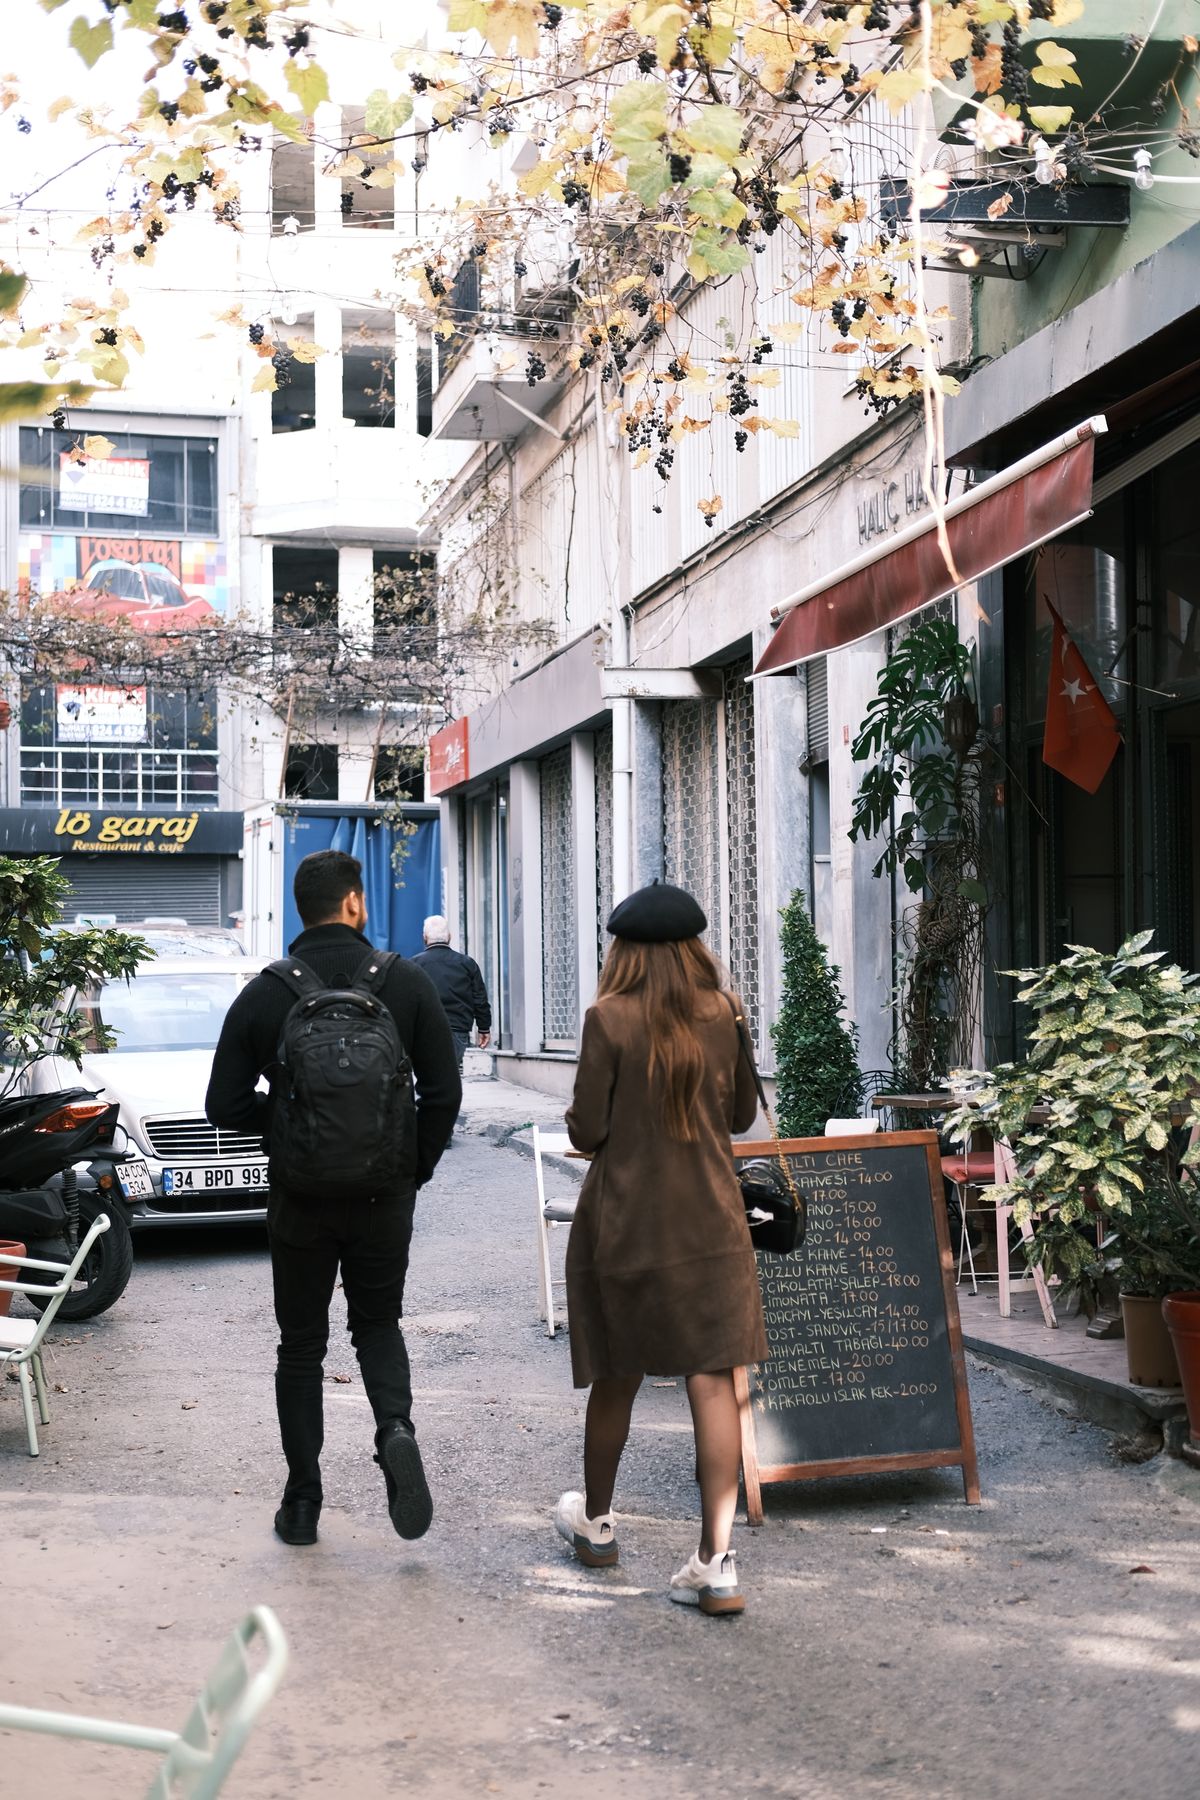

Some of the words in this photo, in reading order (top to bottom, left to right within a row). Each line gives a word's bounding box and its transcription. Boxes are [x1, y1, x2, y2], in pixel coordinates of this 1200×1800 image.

[54, 808, 91, 835] lö
[98, 812, 199, 843] garaj
[72, 840, 142, 852] Restaurant
[144, 840, 154, 852] &
[825, 1153, 863, 1166] CAFE
[118, 1167, 131, 1181] 34
[130, 1163, 147, 1178] CCN
[174, 1171, 193, 1188] 34
[204, 1169, 234, 1187] BPD
[128, 1180, 146, 1195] 534
[808, 1248, 847, 1262] KAHVE
[806, 1262, 849, 1277] KAHVE
[805, 1322, 862, 1337] SANDVİÇ
[833, 1335, 883, 1352] TABAĞI
[764, 1357, 840, 1374] MENEMEN
[768, 1374, 818, 1391] OMLET
[768, 1393, 830, 1411] KAKAOLU
[834, 1388, 867, 1402] ISLAK
[871, 1386, 894, 1399] KEK
